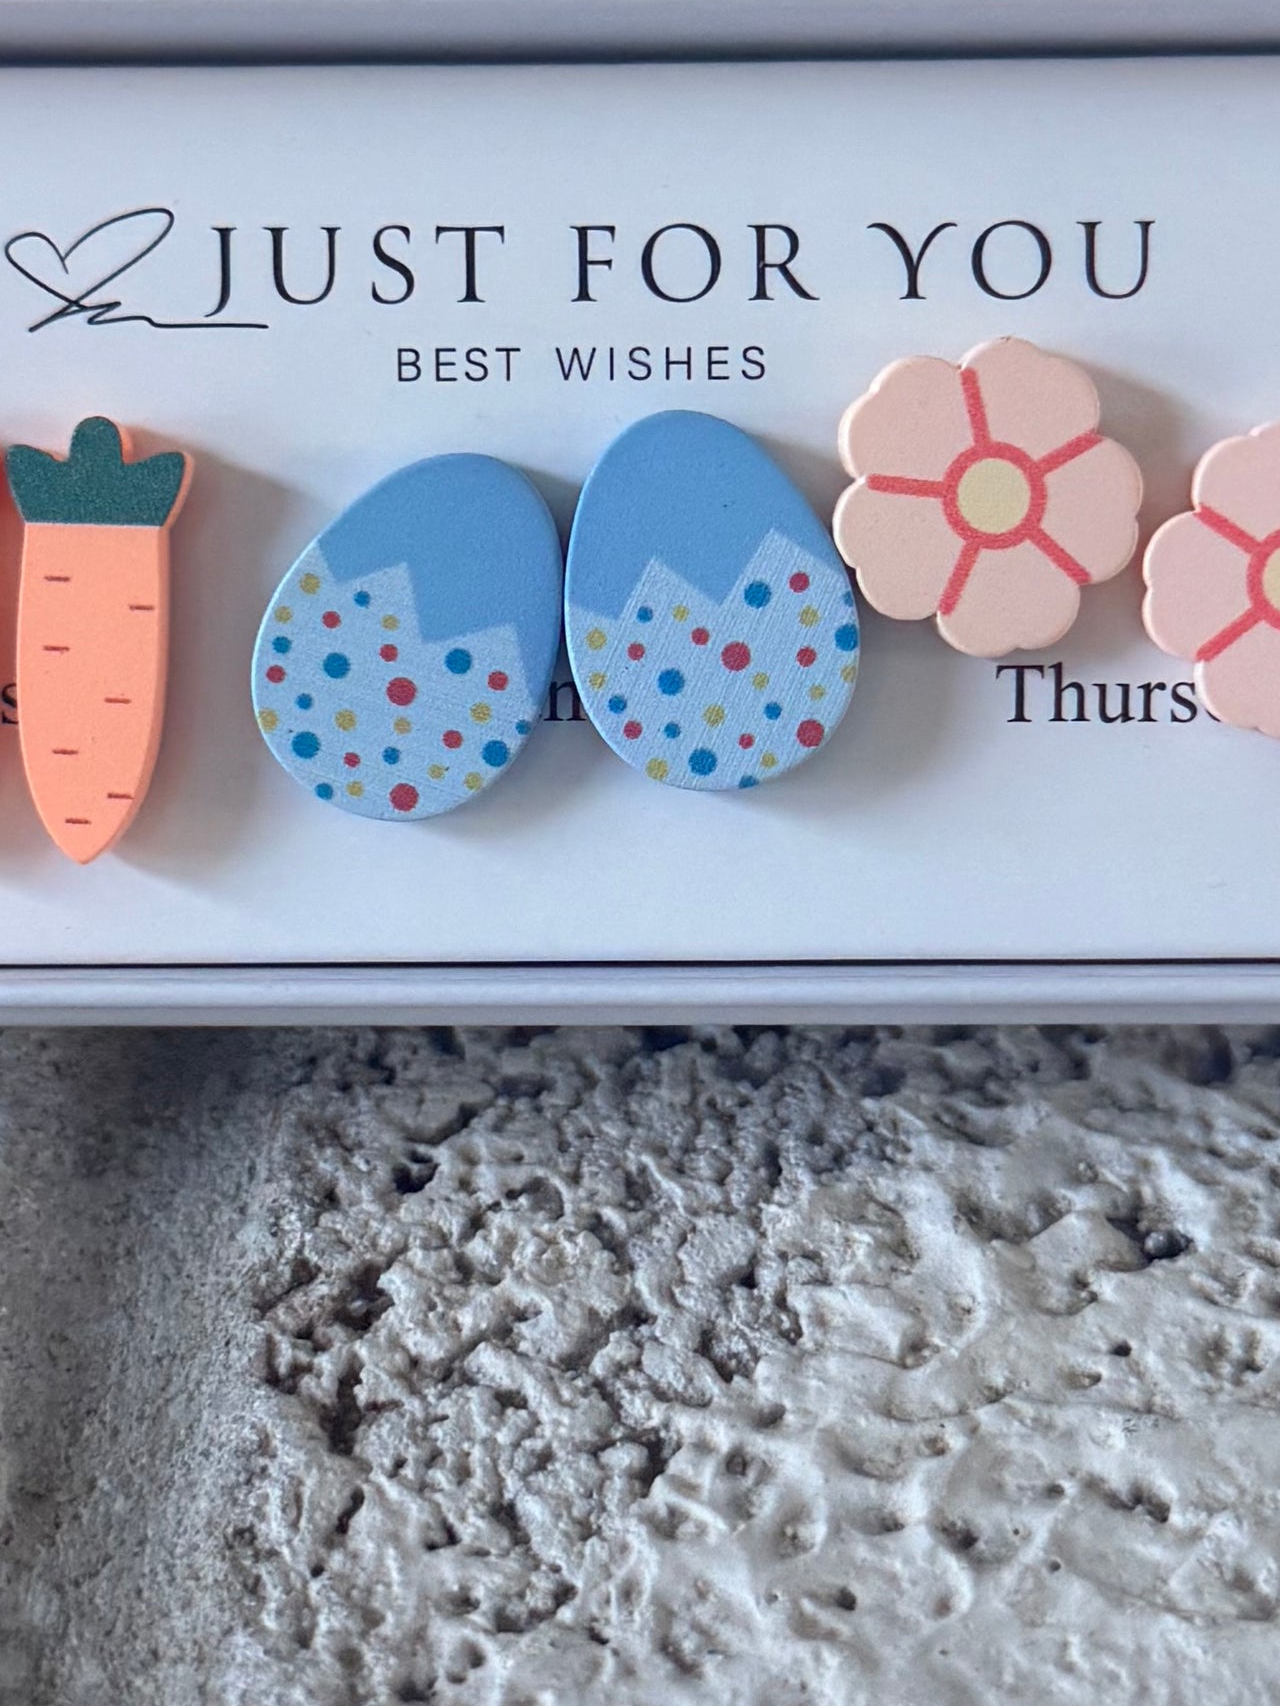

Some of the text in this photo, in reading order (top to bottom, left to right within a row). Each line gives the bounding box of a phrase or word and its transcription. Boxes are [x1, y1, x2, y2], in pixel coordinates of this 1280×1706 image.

[204, 219, 1156, 319] JUST FOR YOU
[396, 345, 767, 383] BEST WISHES
[994, 661, 1221, 725] Thurs
